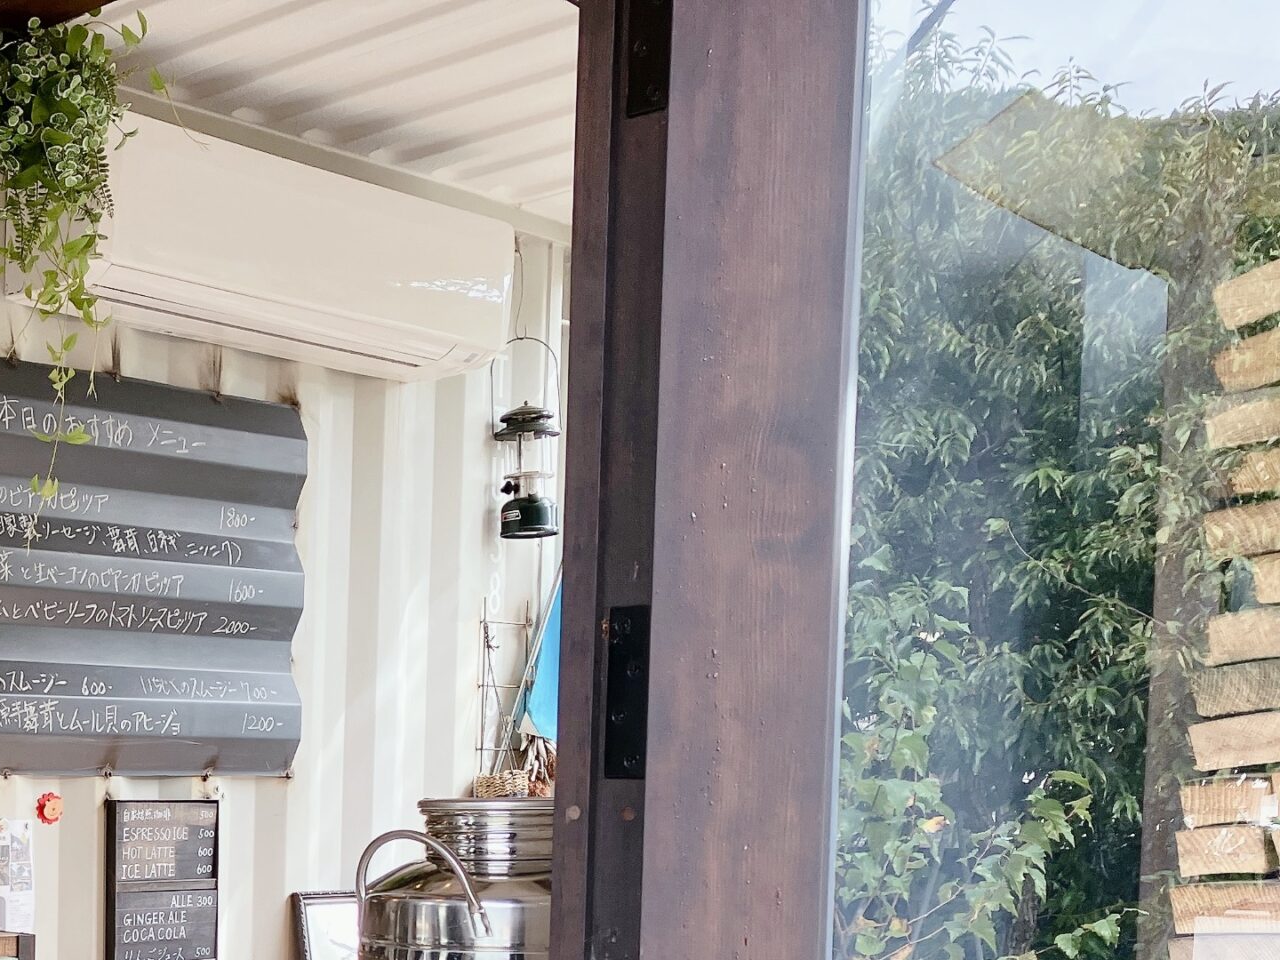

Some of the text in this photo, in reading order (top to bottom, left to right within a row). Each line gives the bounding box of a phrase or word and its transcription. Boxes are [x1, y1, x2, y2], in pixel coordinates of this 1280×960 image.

[123, 826, 215, 842] ESPRESSO ICE 500
[122, 846, 213, 860] HOT LATTE 600
[121, 862, 212, 879] ICE LATTE 600
[196, 896, 213, 907] 300
[123, 911, 187, 926] GINGER ALE
[123, 926, 187, 943] COCA COLA
[195, 946, 211, 958] 500
